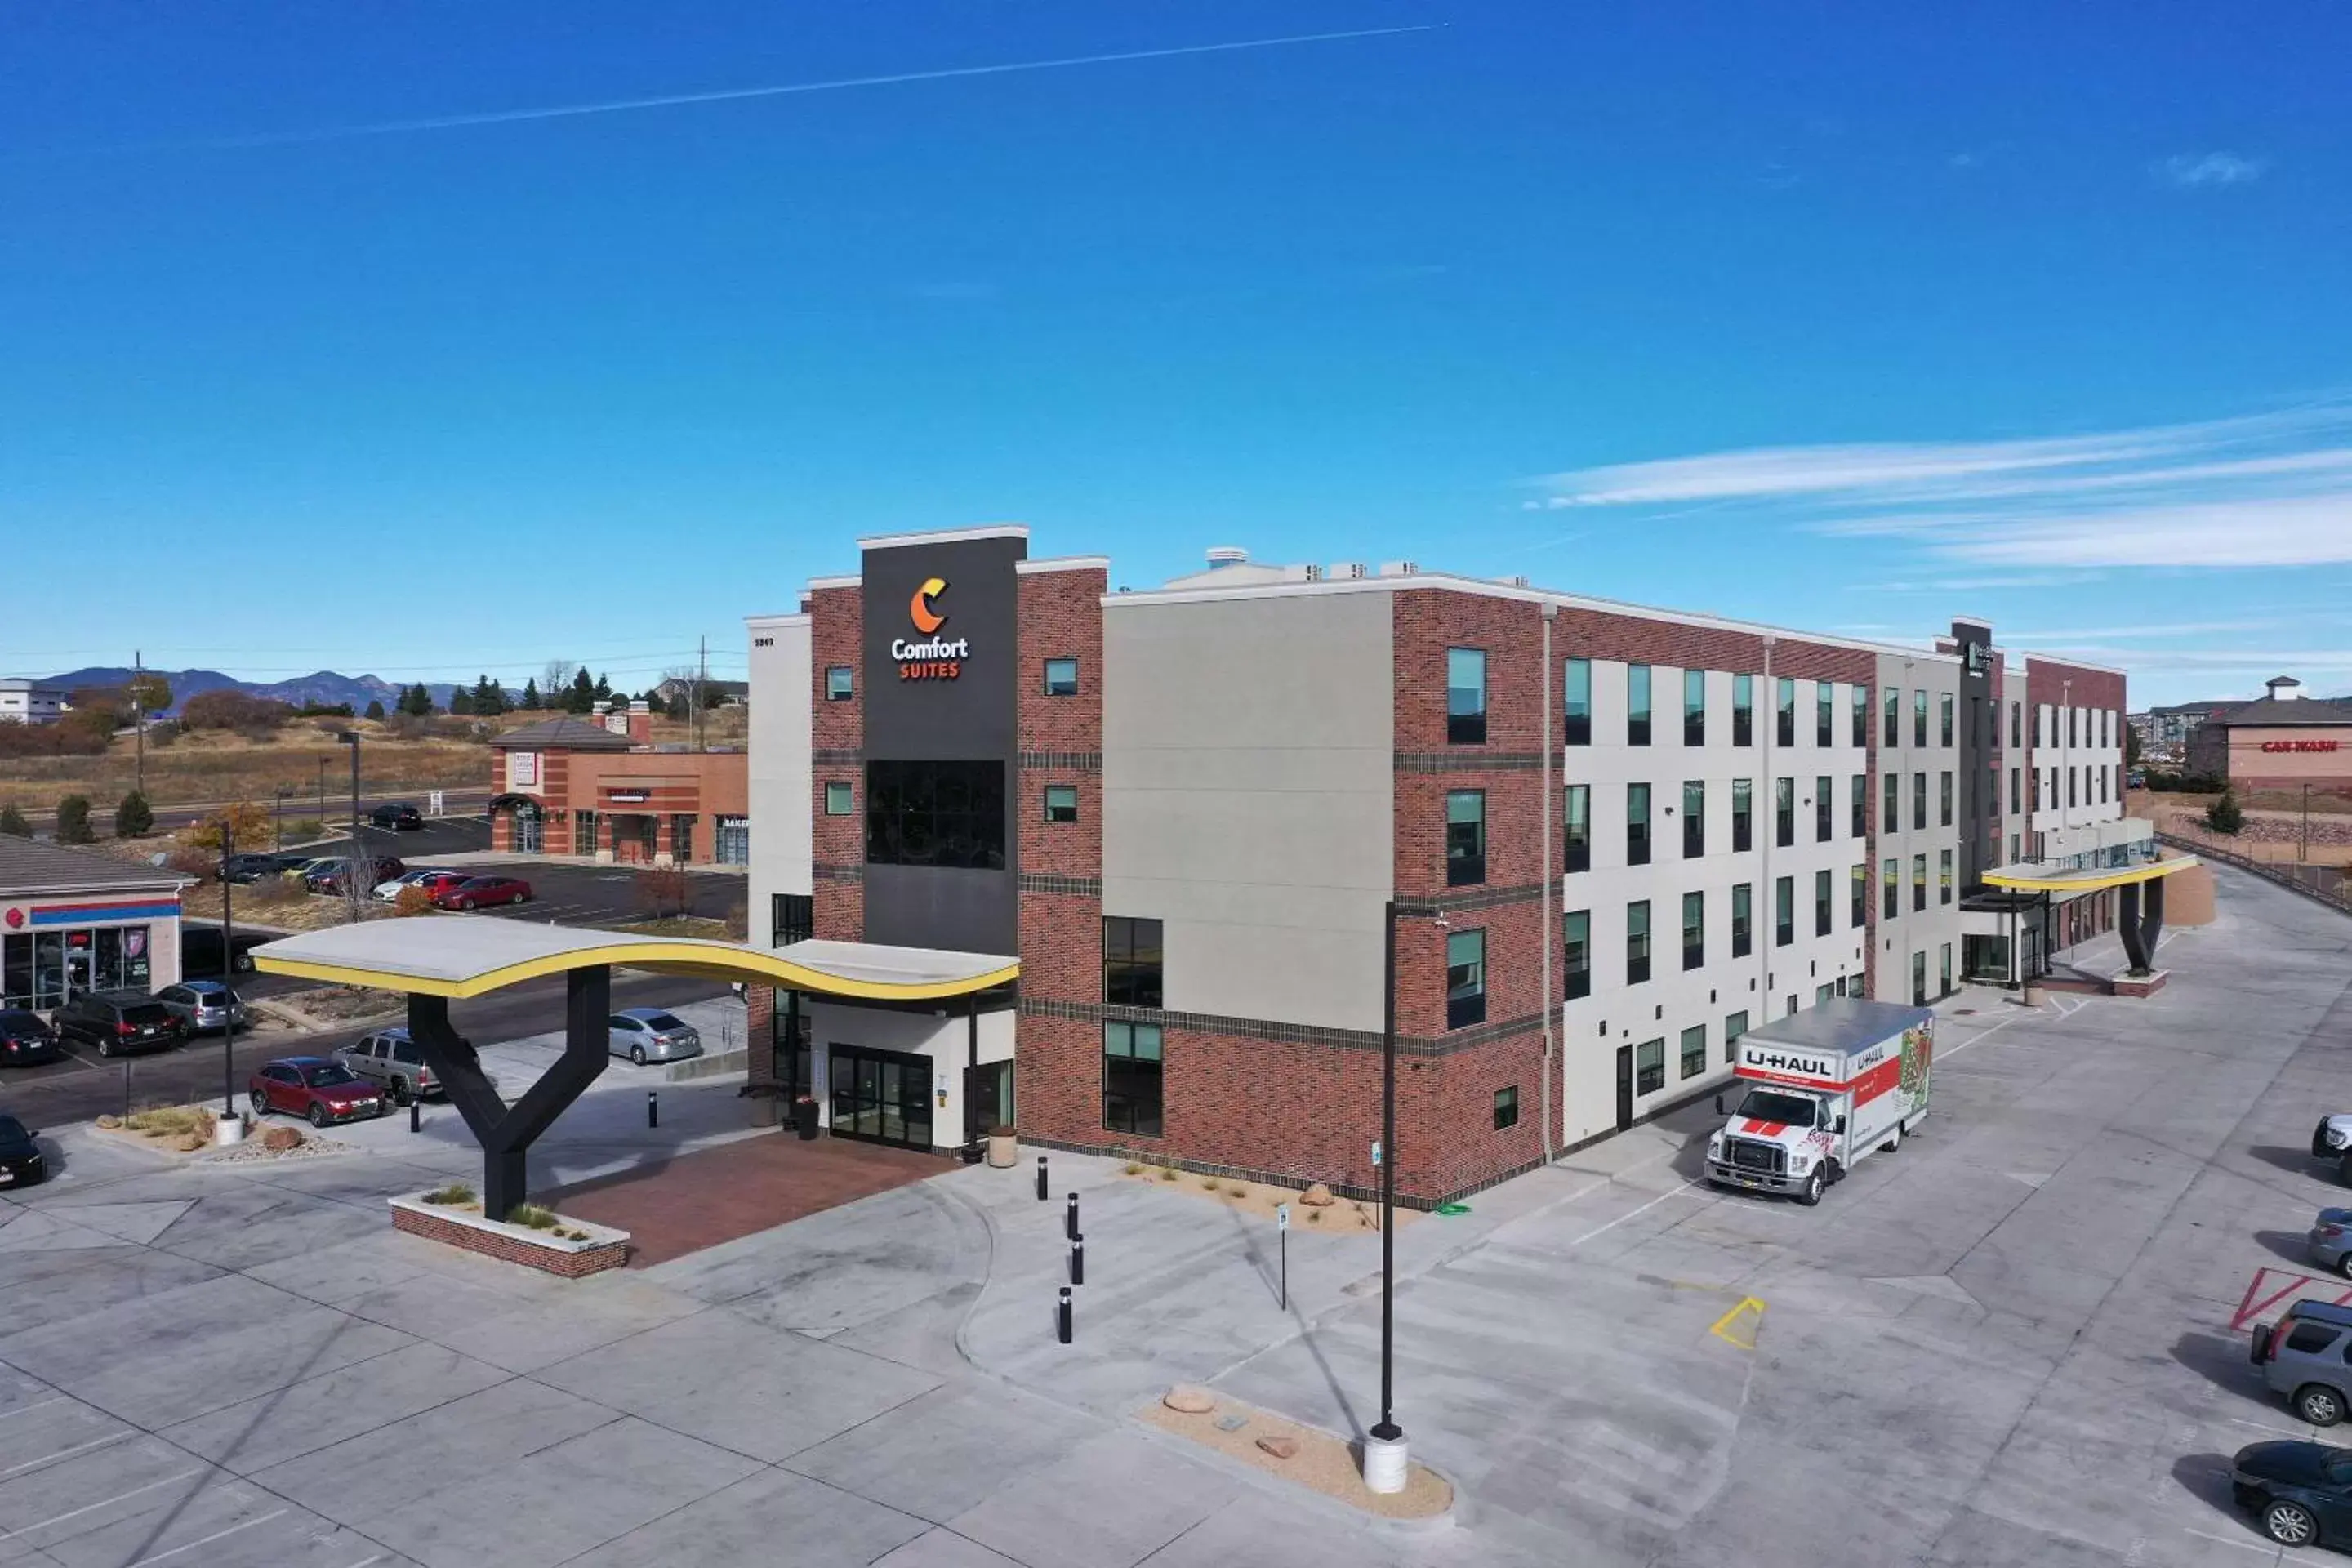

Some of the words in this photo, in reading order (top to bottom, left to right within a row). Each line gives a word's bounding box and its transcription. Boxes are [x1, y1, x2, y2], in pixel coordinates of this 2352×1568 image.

[891, 635, 969, 660] Comfort
[899, 662, 960, 679] SUITES
[2261, 740, 2291, 752] CAR
[2296, 739, 2338, 752] WASH
[1746, 1050, 1831, 1076] U-HAUL
